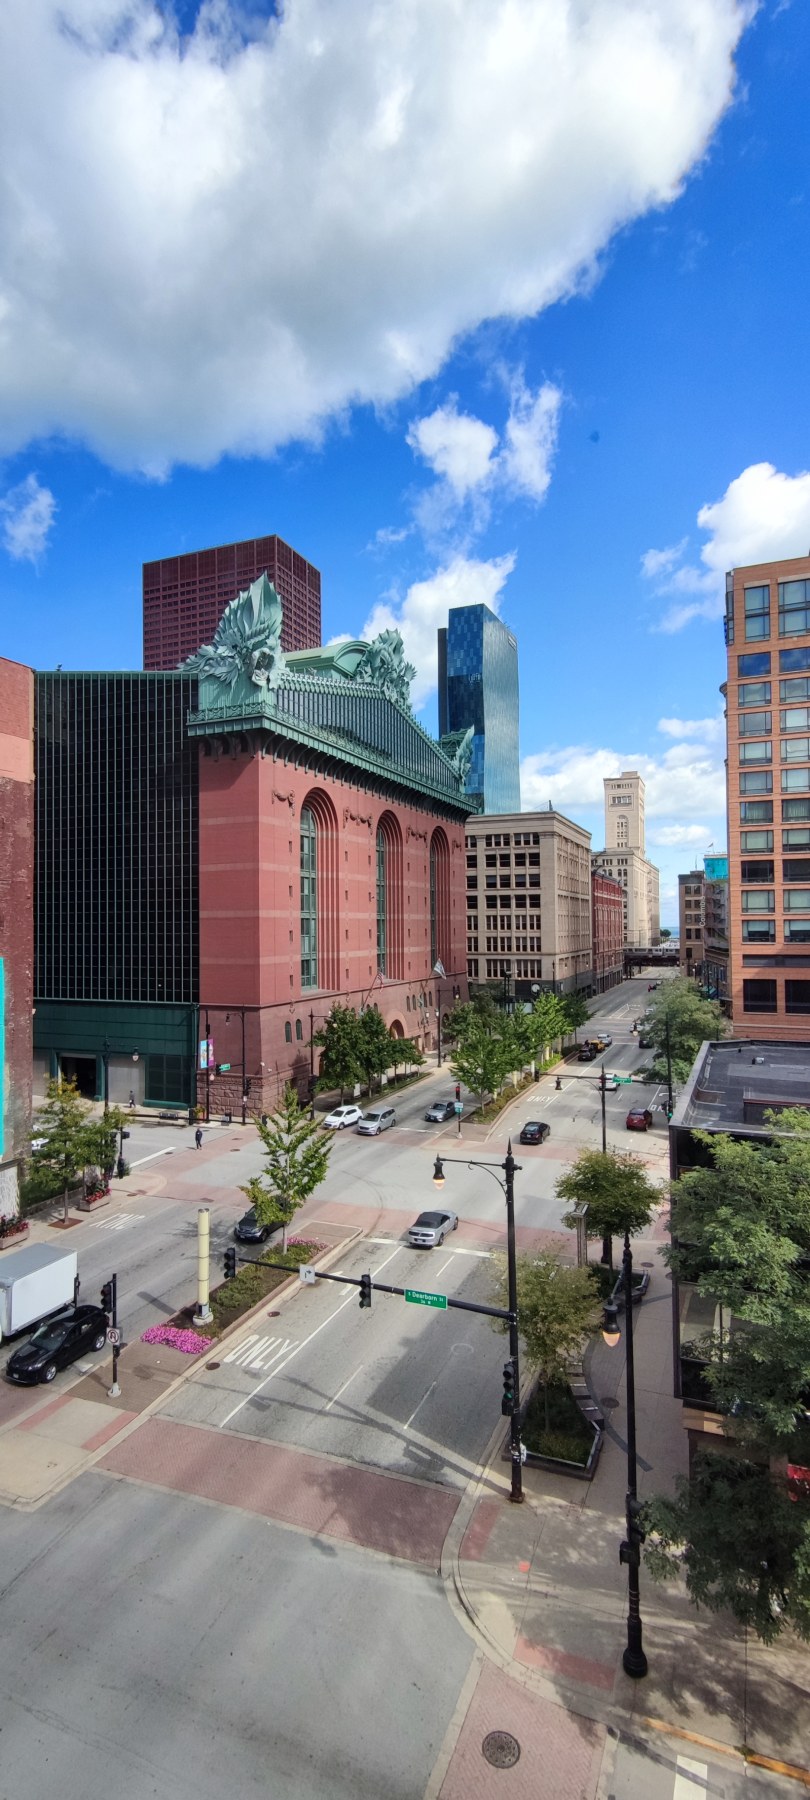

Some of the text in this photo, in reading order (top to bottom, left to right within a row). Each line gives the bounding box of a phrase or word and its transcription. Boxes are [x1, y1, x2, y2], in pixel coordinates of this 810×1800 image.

[526, 1095, 554, 1103] ONLY
[412, 1291, 437, 1301] Dearborn
[223, 1334, 300, 1370] ONLY
